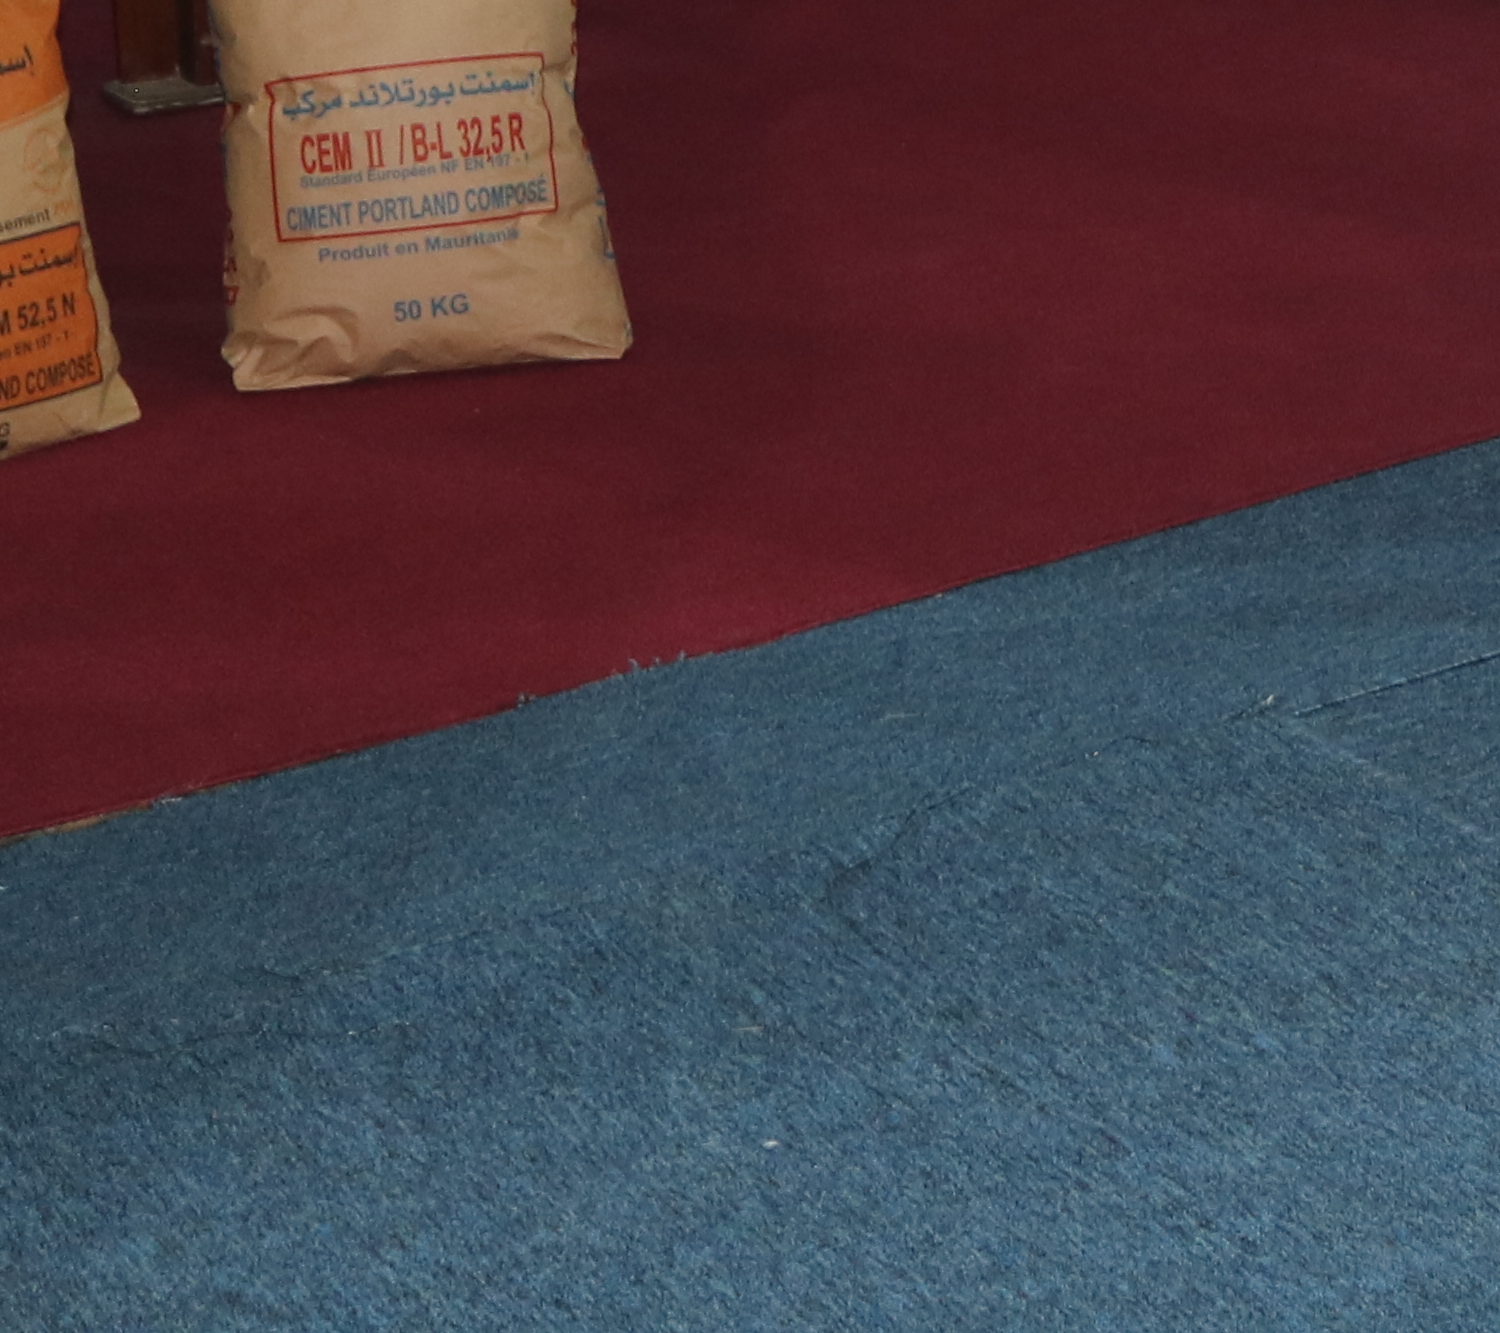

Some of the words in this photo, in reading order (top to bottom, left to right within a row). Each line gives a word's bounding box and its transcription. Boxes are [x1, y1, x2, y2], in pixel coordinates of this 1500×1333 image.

[282, 88, 343, 122] مركب
[349, 77, 456, 109] بورتلاند
[300, 130, 352, 175] CEM
[410, 121, 453, 163] B-L
[457, 114, 505, 162] 32,5
[508, 111, 526, 152] R
[286, 200, 361, 231] CIMENT
[358, 191, 459, 224] PORTLAND
[465, 173, 548, 213] COMPOSÉ
[318, 243, 389, 263] Produit
[395, 241, 419, 255] en
[425, 226, 520, 253] Mauritanie
[17, 297, 59, 331] 52,5
[61, 292, 76, 317] N
[394, 299, 422, 323] 50
[431, 293, 471, 318] KG
